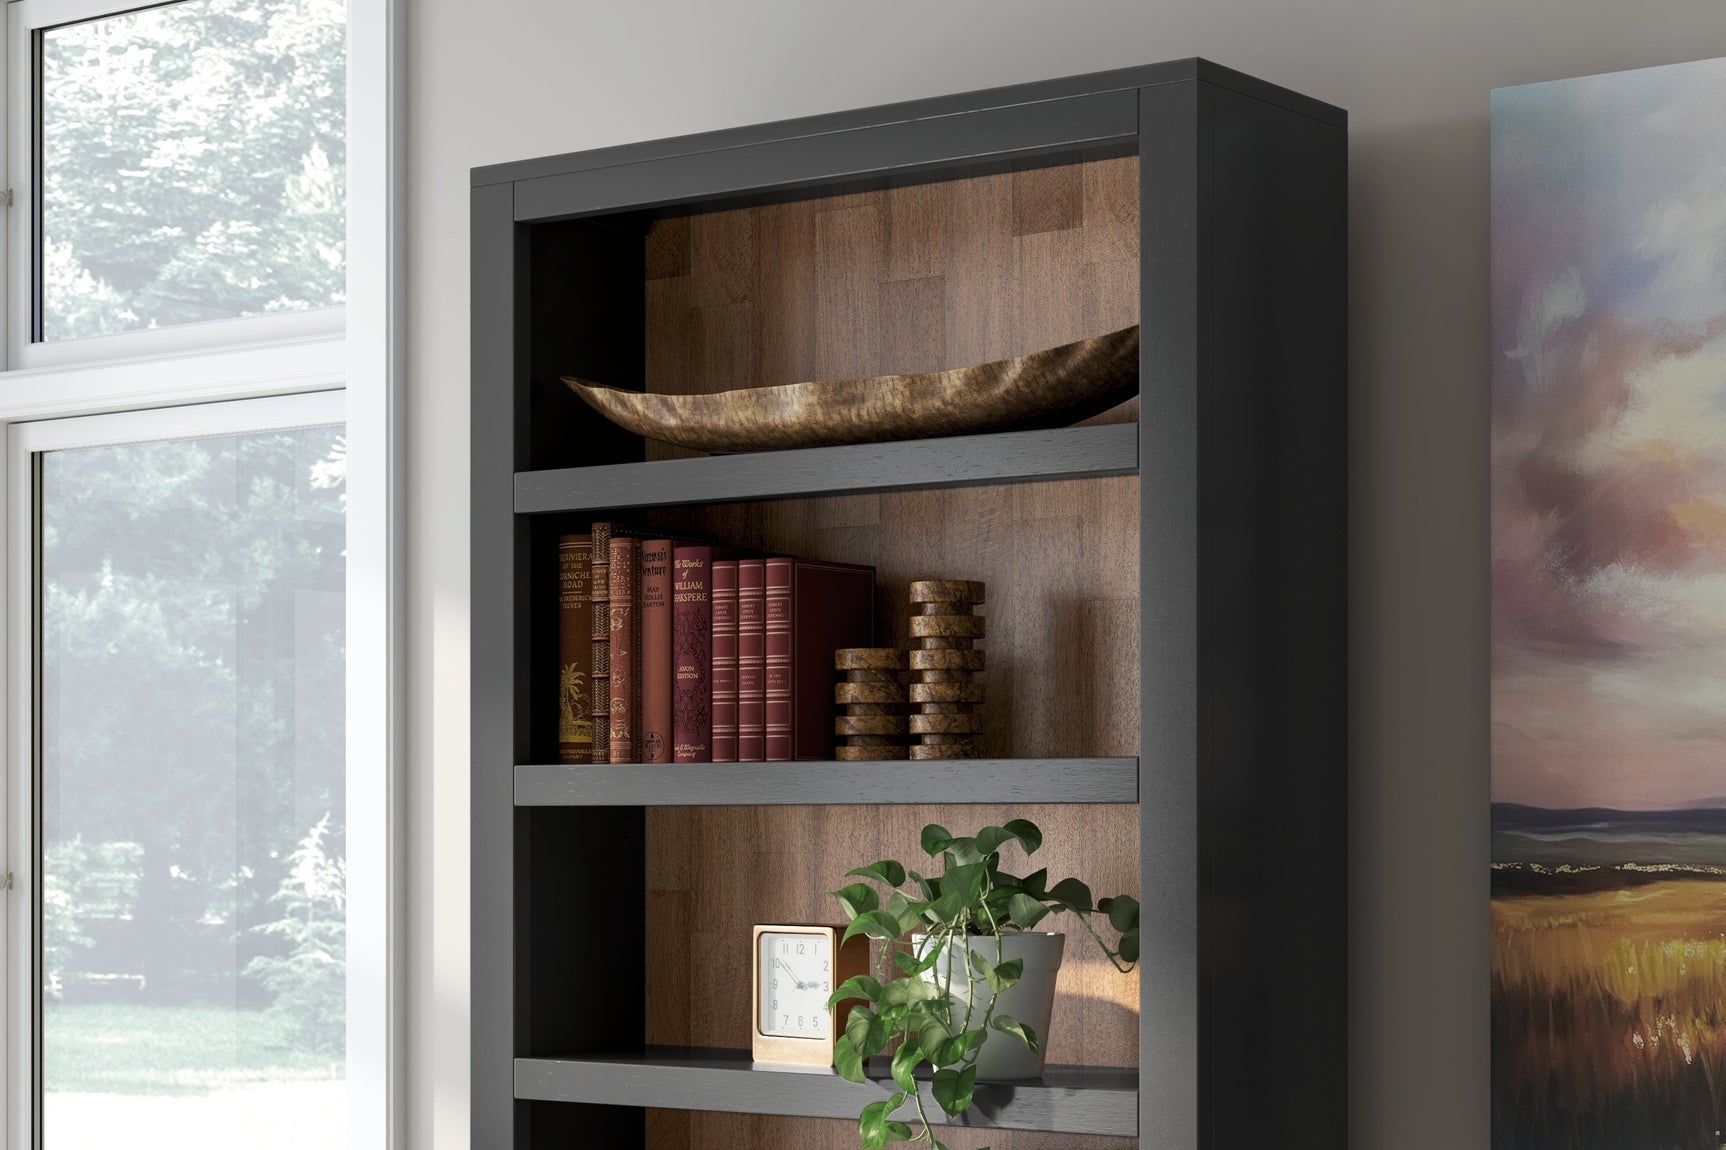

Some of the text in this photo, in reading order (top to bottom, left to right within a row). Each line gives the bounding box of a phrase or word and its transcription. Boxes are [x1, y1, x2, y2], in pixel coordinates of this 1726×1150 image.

[682, 559, 703, 568] Works
[682, 569, 688, 579] of
[563, 580, 584, 588] ROAD
[675, 582, 703, 590] WILLIAM
[782, 943, 789, 954] 11
[796, 943, 805, 955] 12
[814, 944, 817, 955] 1
[771, 958, 780, 969] 10
[823, 960, 829, 972] 2
[772, 978, 778, 990] 9
[823, 981, 829, 992] 3
[772, 999, 778, 1010] 8
[822, 1001, 829, 1013] 4
[783, 1015, 789, 1027] 7
[798, 1016, 804, 1027] 6
[813, 1016, 818, 1027] 5
